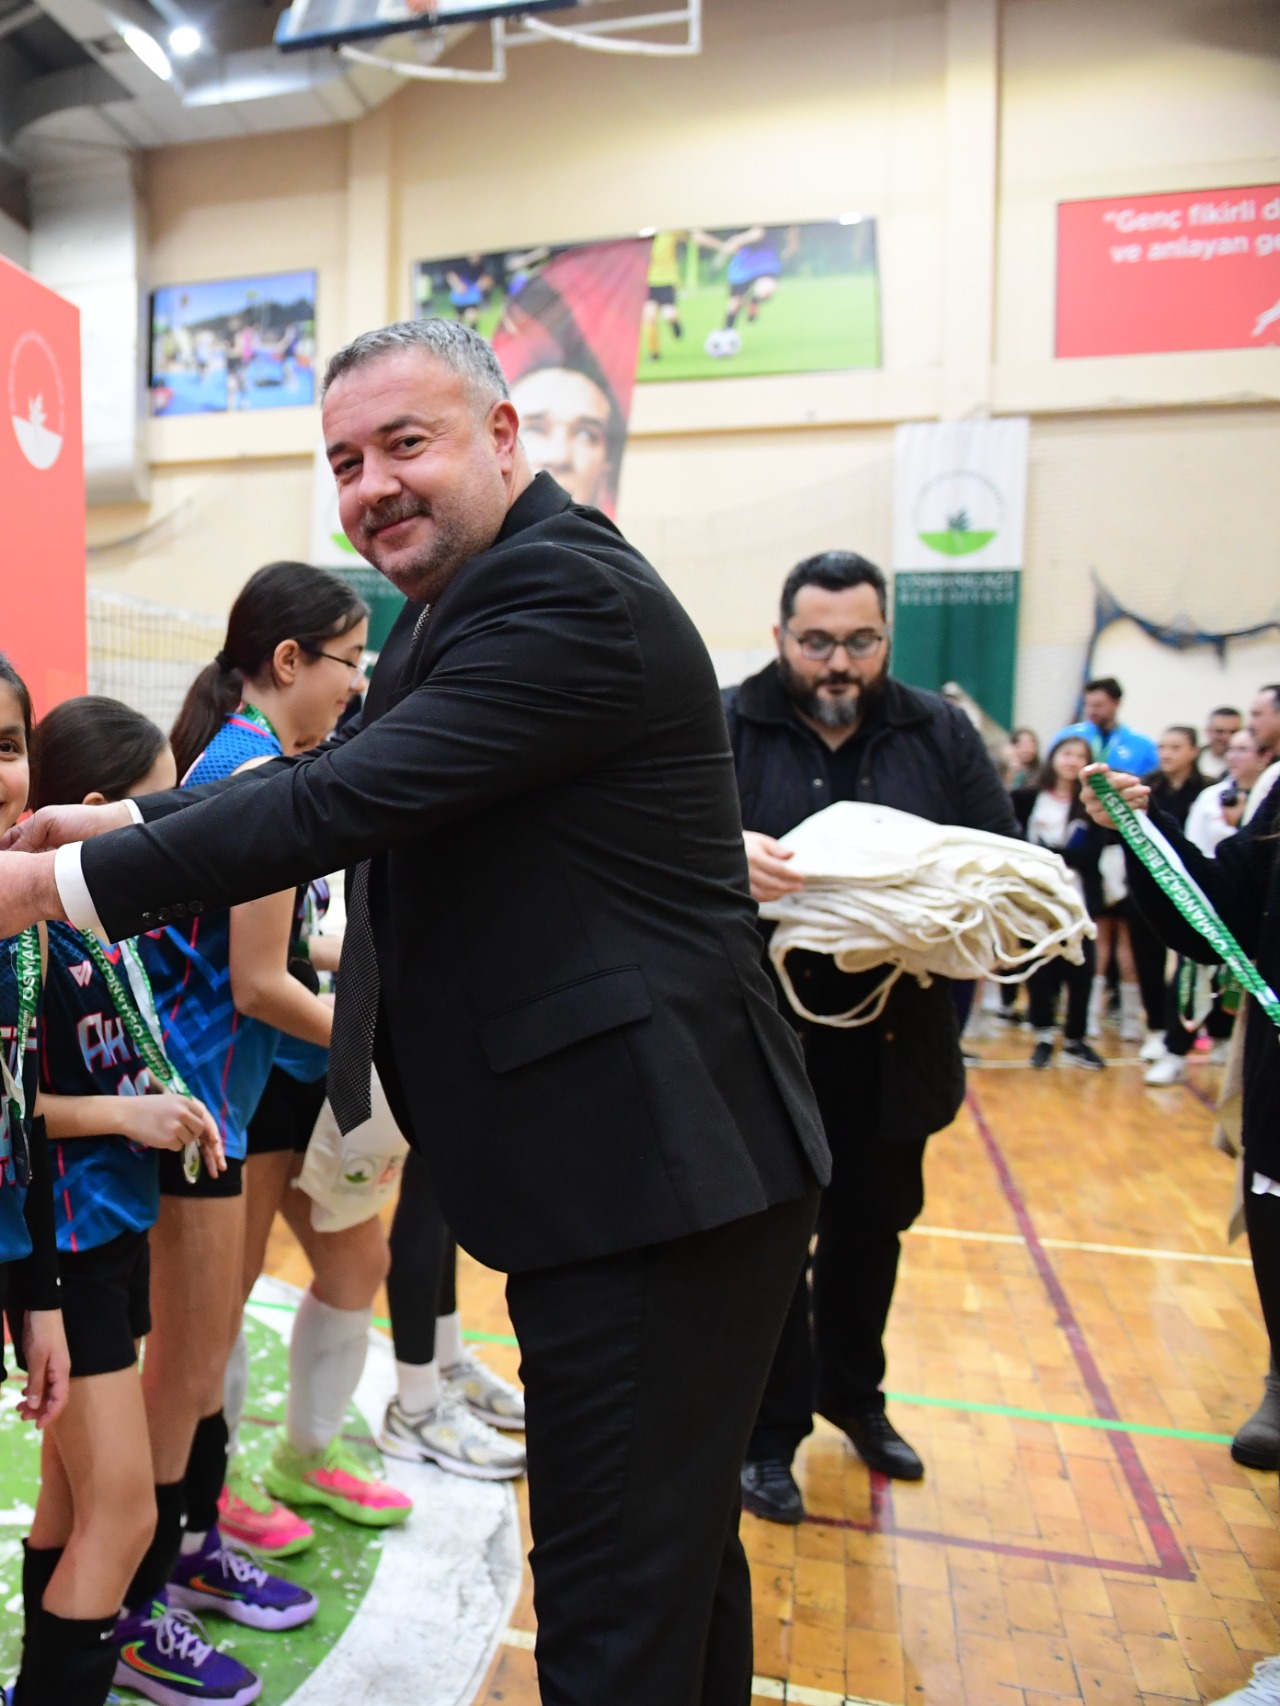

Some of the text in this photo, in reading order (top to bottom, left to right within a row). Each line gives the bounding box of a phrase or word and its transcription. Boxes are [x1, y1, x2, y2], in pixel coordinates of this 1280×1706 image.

[1188, 199, 1256, 226] fikirli
[1109, 243, 1142, 264] ve
[1147, 235, 1250, 262] anlayan
